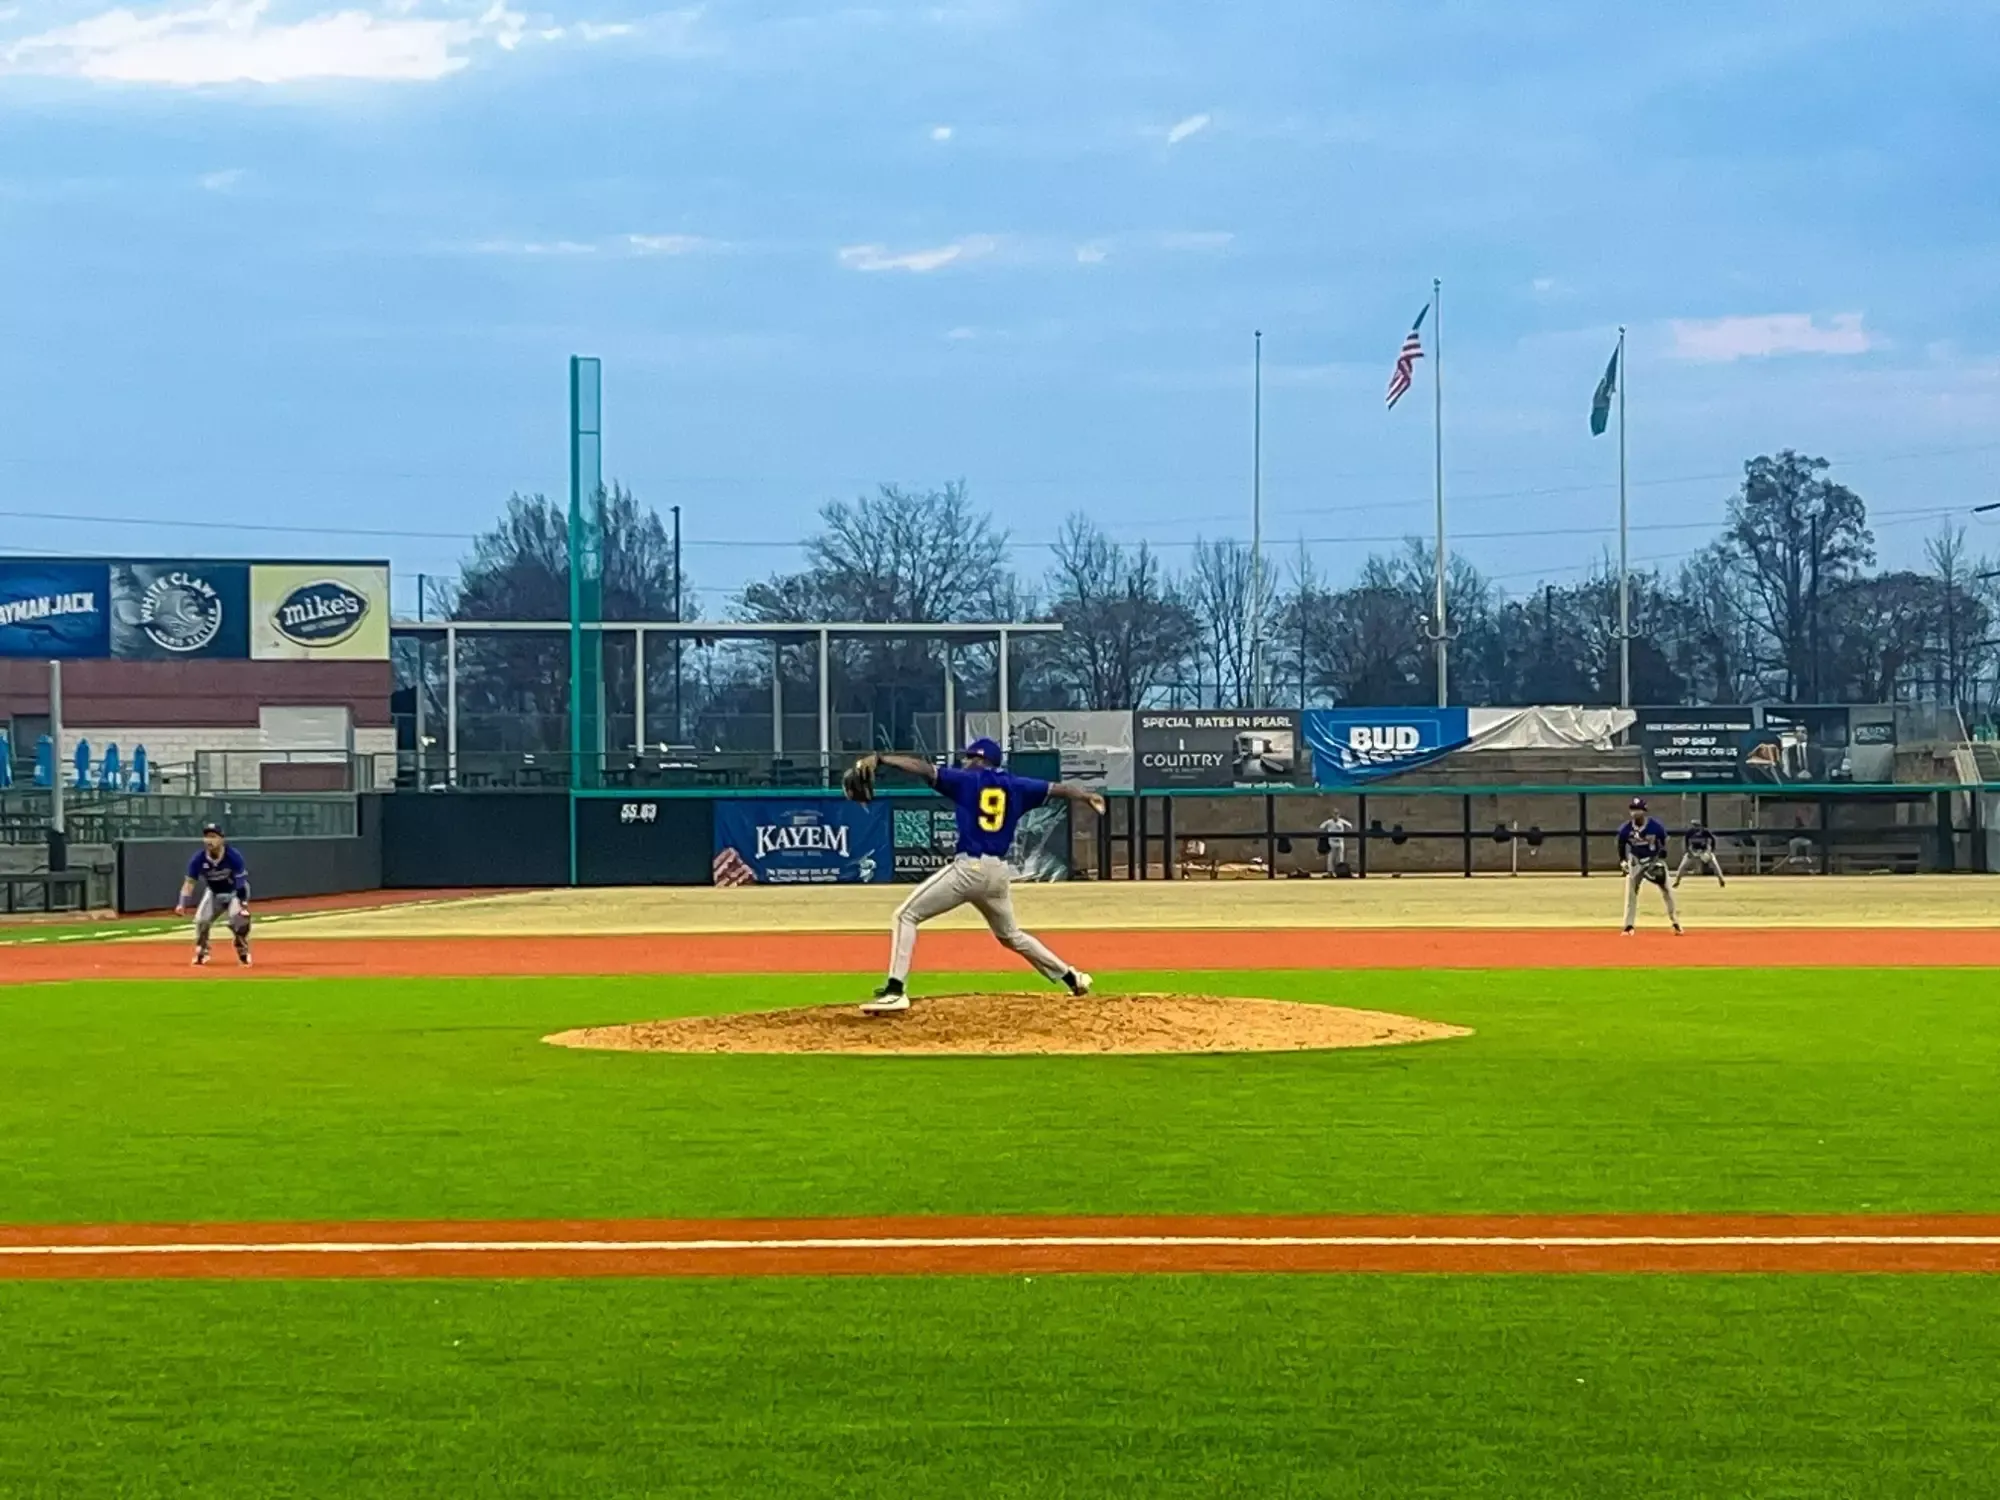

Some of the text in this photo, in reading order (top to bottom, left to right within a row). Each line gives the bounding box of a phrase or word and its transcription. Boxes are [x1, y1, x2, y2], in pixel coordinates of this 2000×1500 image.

[51, 592, 95, 615] JACK
[140, 572, 217, 623] WHITE CLAW
[283, 593, 360, 626] mike's
[1142, 716, 1293, 728] SPECIAL RATES IN PEARL
[1350, 726, 1420, 751] BUD
[1142, 753, 1224, 767] COUNTRY
[1653, 747, 1683, 757] HAPPY
[978, 787, 1006, 833] 9
[754, 824, 850, 860] KAYEM
